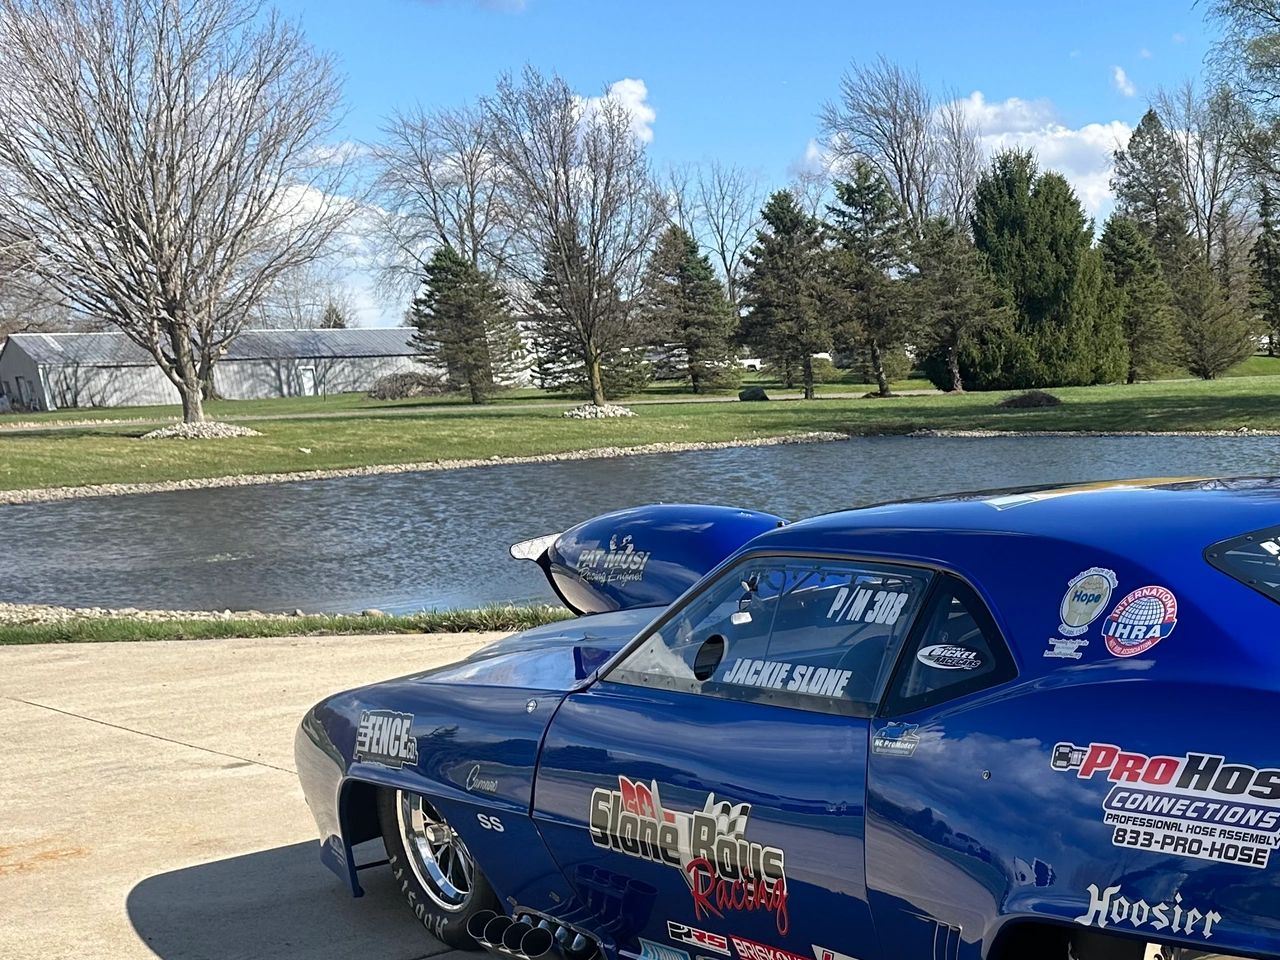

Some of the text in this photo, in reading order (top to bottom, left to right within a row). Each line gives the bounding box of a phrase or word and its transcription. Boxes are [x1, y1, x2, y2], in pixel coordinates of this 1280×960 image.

[576, 550, 651, 570] PAT MUSI
[826, 585, 909, 625] P/M 308
[1072, 589, 1102, 605] Hope
[1112, 587, 1175, 620] INTERNATIONAL
[1108, 622, 1161, 639] IHRA
[931, 648, 977, 659] BICKEL
[722, 658, 853, 697] JACKIE SLONE
[369, 715, 411, 758] FENCE
[477, 813, 505, 832] SS
[590, 788, 681, 868] Slone
[1105, 813, 1183, 833] PROFESSIONAL
[1186, 825, 1217, 838] HOSE
[1114, 828, 1269, 866] 833-PRO-HOSE
[686, 857, 789, 936] Racing
[1074, 884, 1222, 939] Hoosier
